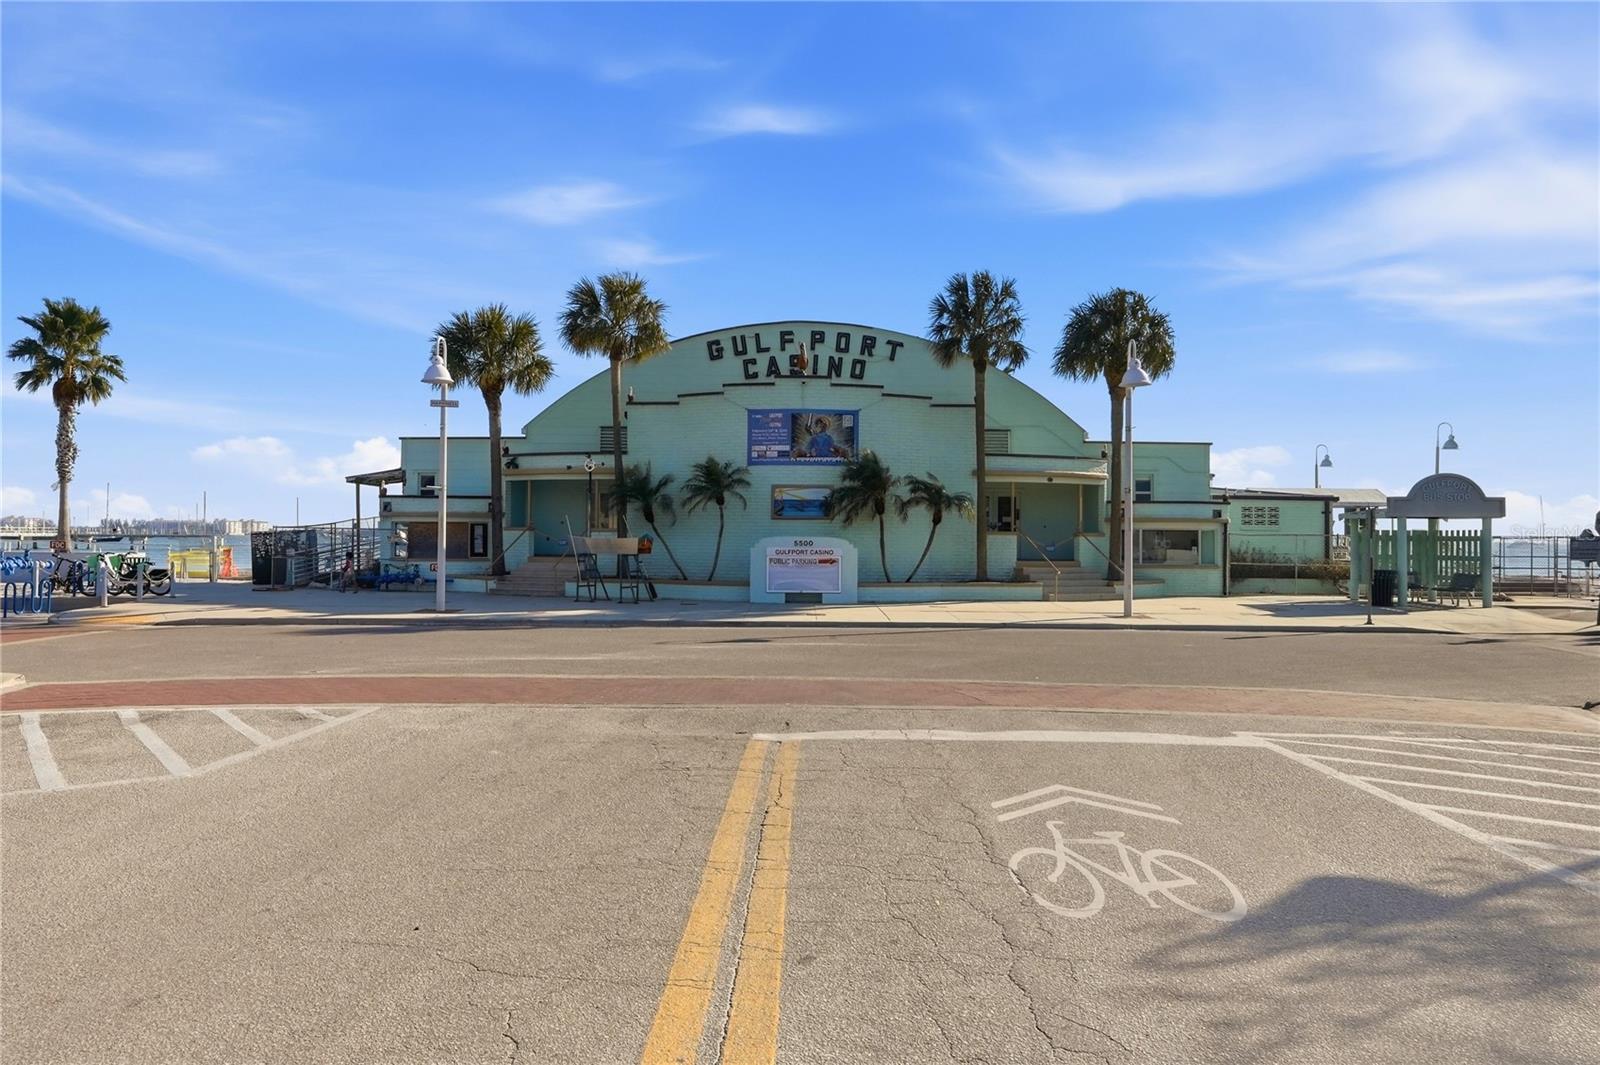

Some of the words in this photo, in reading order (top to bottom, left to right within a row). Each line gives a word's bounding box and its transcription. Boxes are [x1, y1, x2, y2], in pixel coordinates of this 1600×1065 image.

[707, 330, 904, 361] GULFPORT
[1423, 479, 1474, 493] GULFPORT
[1424, 493, 1442, 501] BUS
[1447, 493, 1472, 501] STOP
